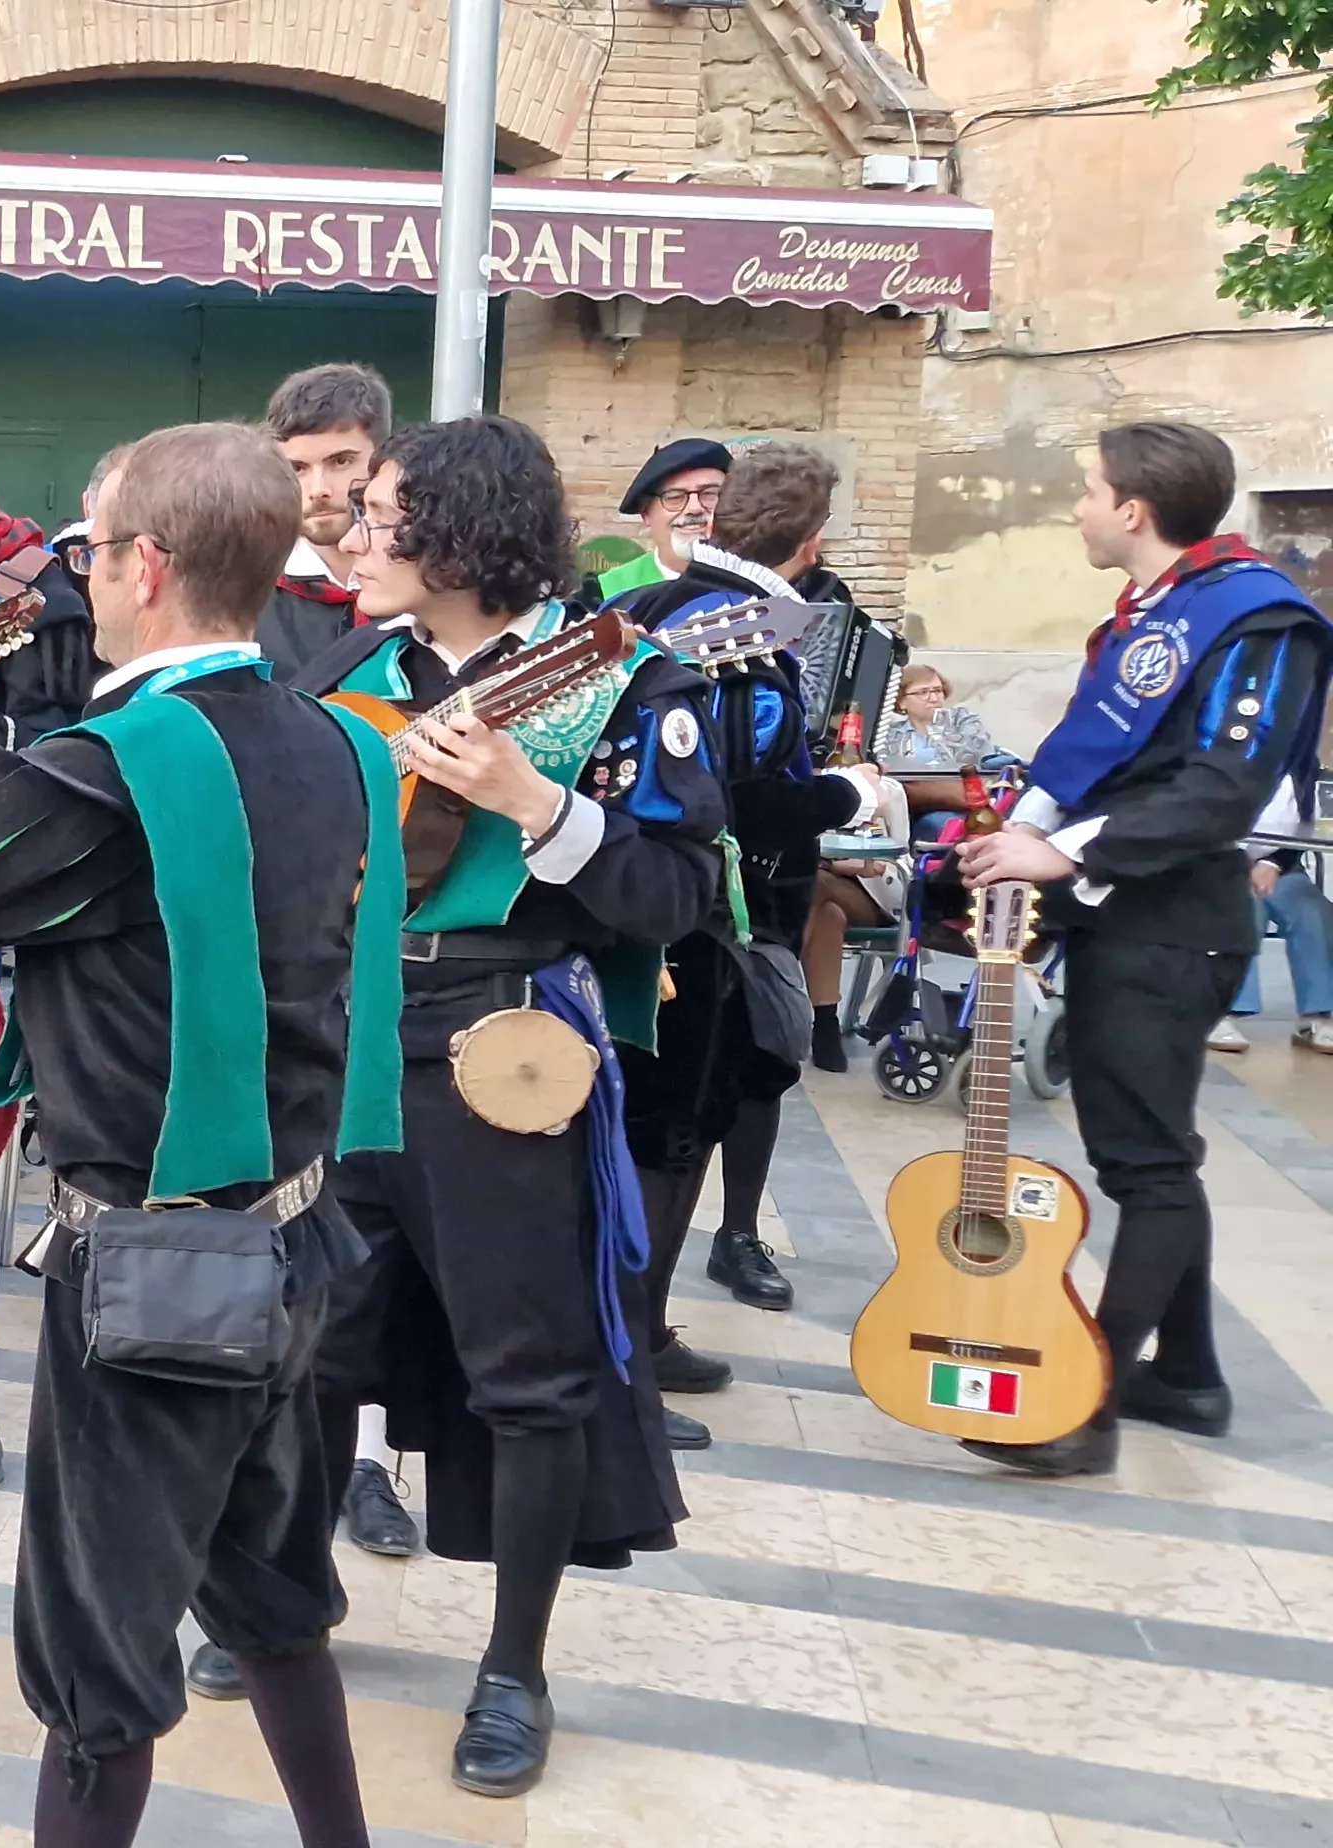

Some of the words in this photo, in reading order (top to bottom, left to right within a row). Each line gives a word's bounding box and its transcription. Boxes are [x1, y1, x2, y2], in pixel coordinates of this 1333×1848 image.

[222, 208, 686, 291] RESTARANTE
[777, 225, 921, 270] Desayunos
[732, 256, 850, 296] Comidas
